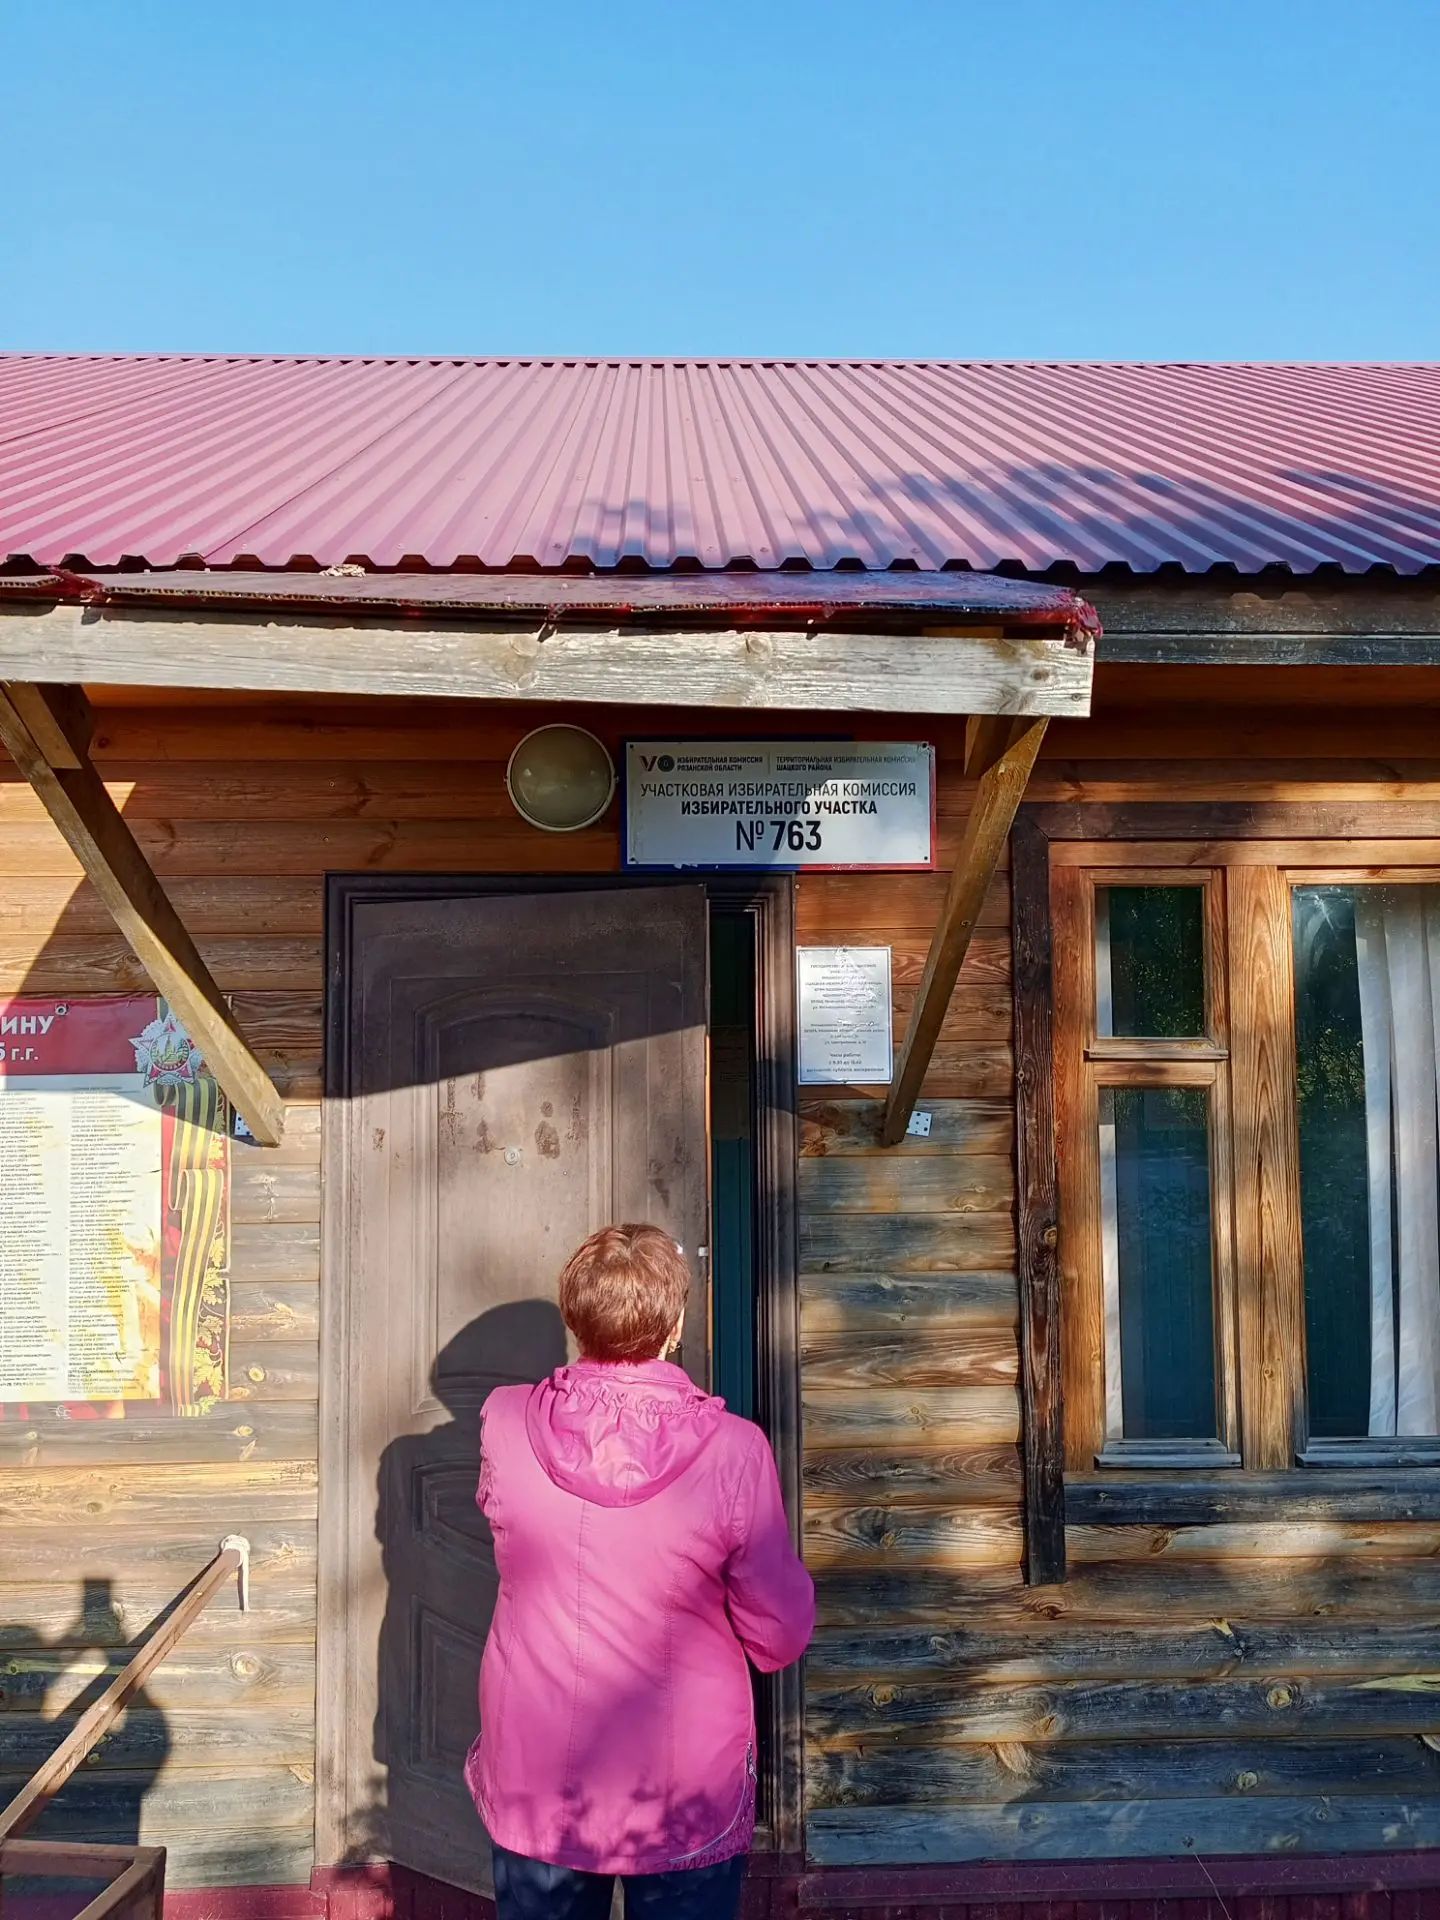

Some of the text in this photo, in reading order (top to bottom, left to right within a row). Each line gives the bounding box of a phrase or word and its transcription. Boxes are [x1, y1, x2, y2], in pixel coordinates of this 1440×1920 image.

[677, 756, 728, 764] ИЗБИРАТЕЛЬНАЯ
[776, 756, 833, 764] ТЕРРИТОРИАЛЬНАЯ
[677, 764, 713, 772] РЯЗАНСКОЙ
[808, 763, 832, 772] РАЙОНА
[641, 782, 916, 797] УЧАСТКОВАЯ ИЗБИРАТЕЛЬНАЯ КОМИССИЯ
[681, 800, 878, 815] ИЗБИРАТЕЛЬНОГО УЧАСТКА
[769, 820, 822, 851] 763
